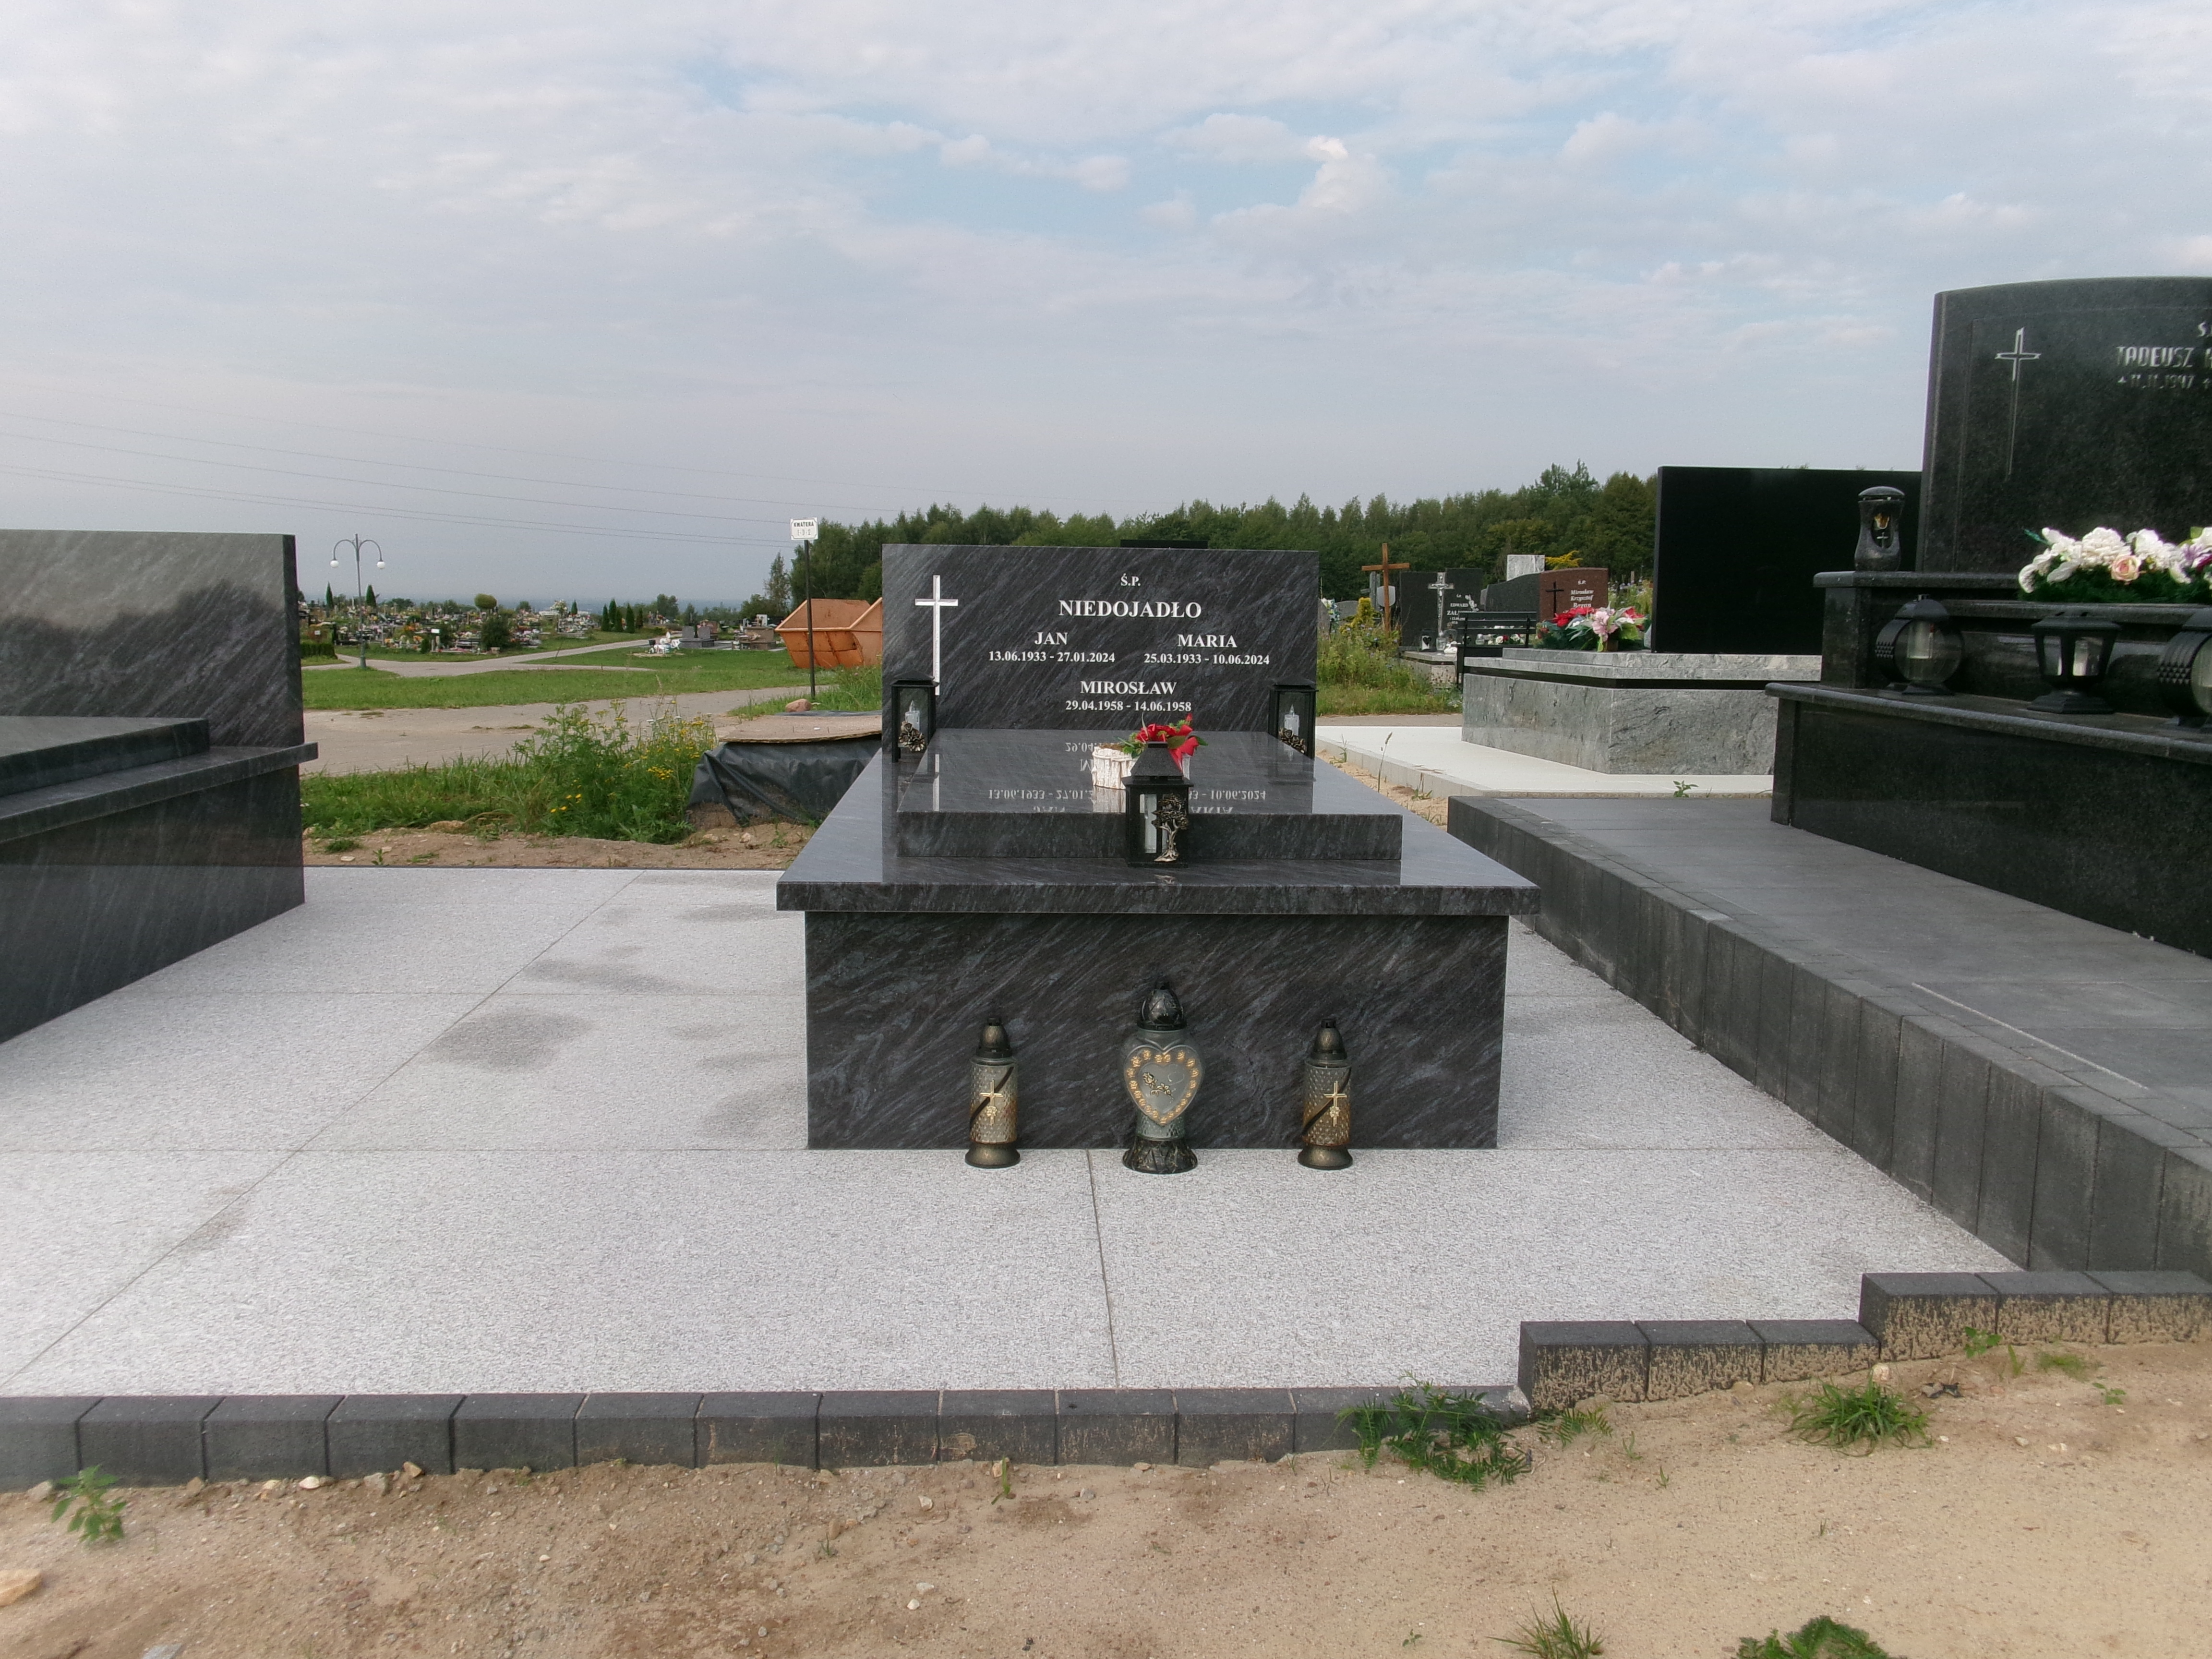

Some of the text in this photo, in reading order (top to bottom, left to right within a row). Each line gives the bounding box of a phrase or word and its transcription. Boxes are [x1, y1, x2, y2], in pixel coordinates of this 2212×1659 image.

[2116, 346, 2194, 368] TADEUSZ
[1120, 573, 1141, 586] Ś.P.
[1058, 600, 1202, 618] NIEDOJADŁO
[1034, 632, 1069, 645] JAN
[1177, 634, 1238, 648] MARIA
[988, 650, 1046, 661] 13.06.1933
[1057, 652, 1115, 662] 27.01.2024
[1143, 653, 1202, 664] 25.03.1933
[1213, 654, 1270, 665] 10.06.2024
[1080, 681, 1177, 695] MIROSŁAW
[1065, 700, 1123, 711] 29.04.1958
[1134, 701, 1192, 712] 14.06.1958
